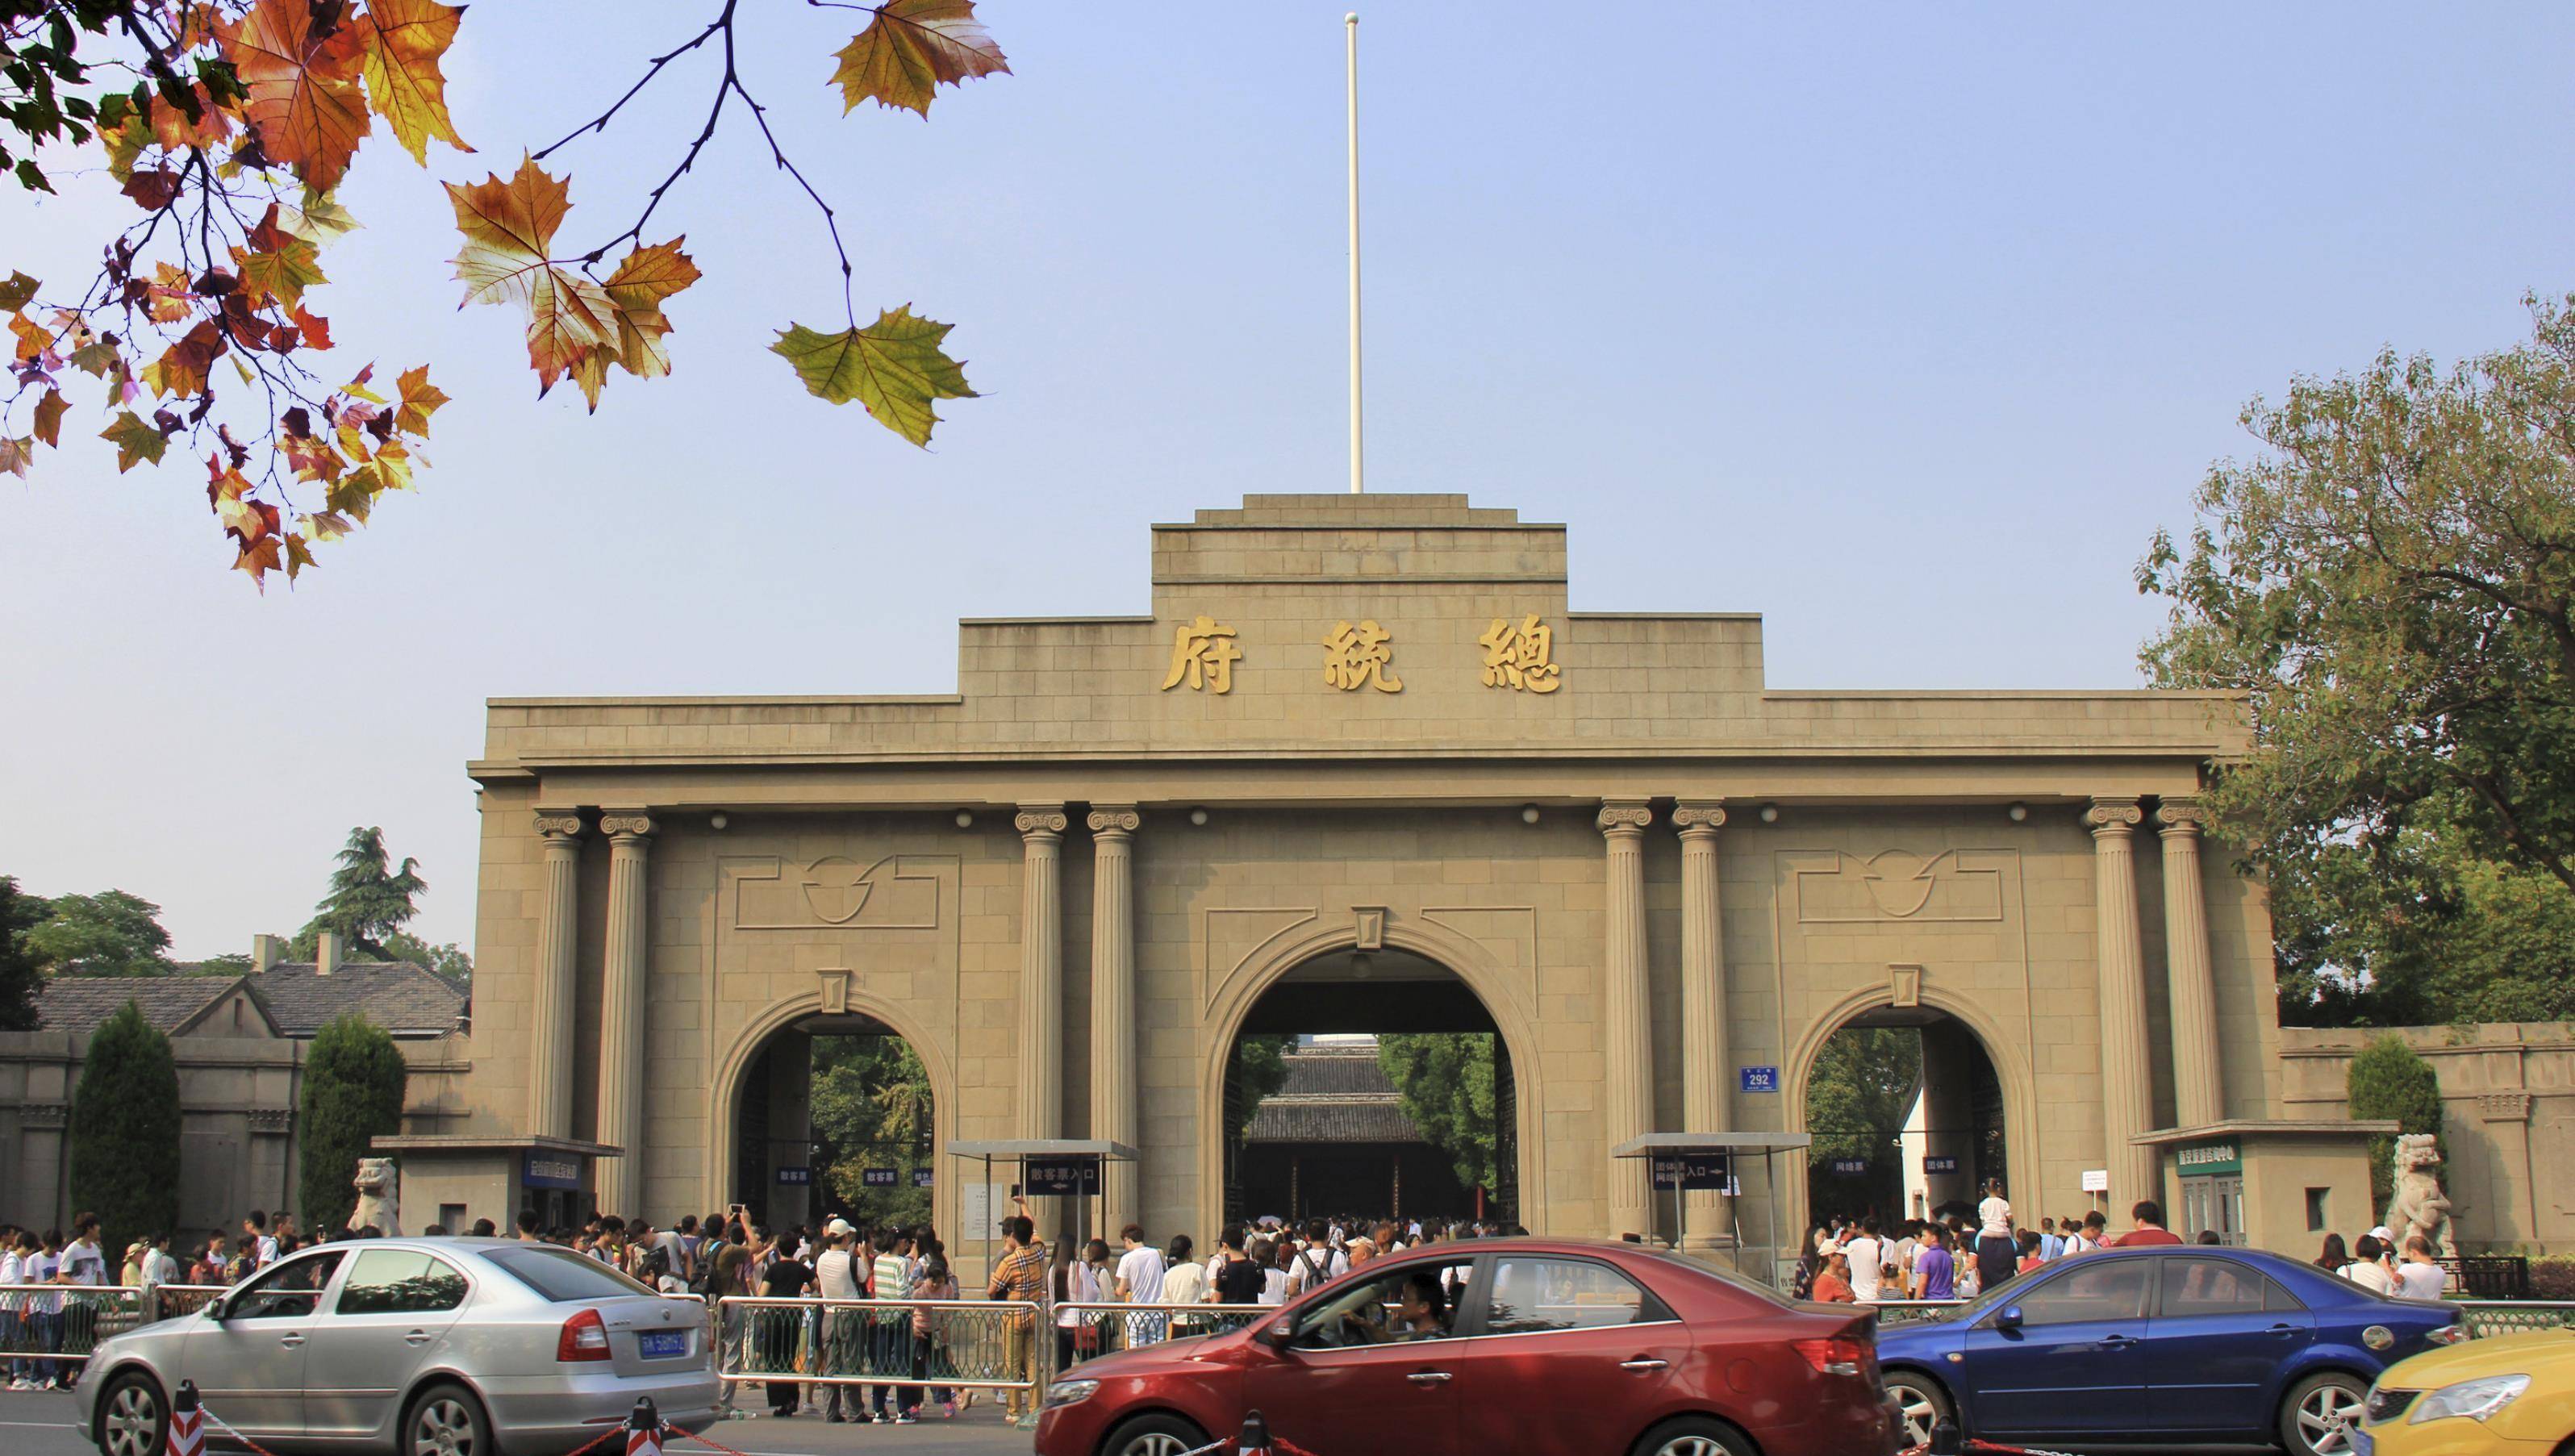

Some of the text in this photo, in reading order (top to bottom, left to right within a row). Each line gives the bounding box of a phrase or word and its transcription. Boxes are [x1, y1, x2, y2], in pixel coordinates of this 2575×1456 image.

[1749, 1074, 1769, 1085] 292
[866, 1172, 895, 1182] 散客票
[1687, 1166, 1705, 1177] 入口
